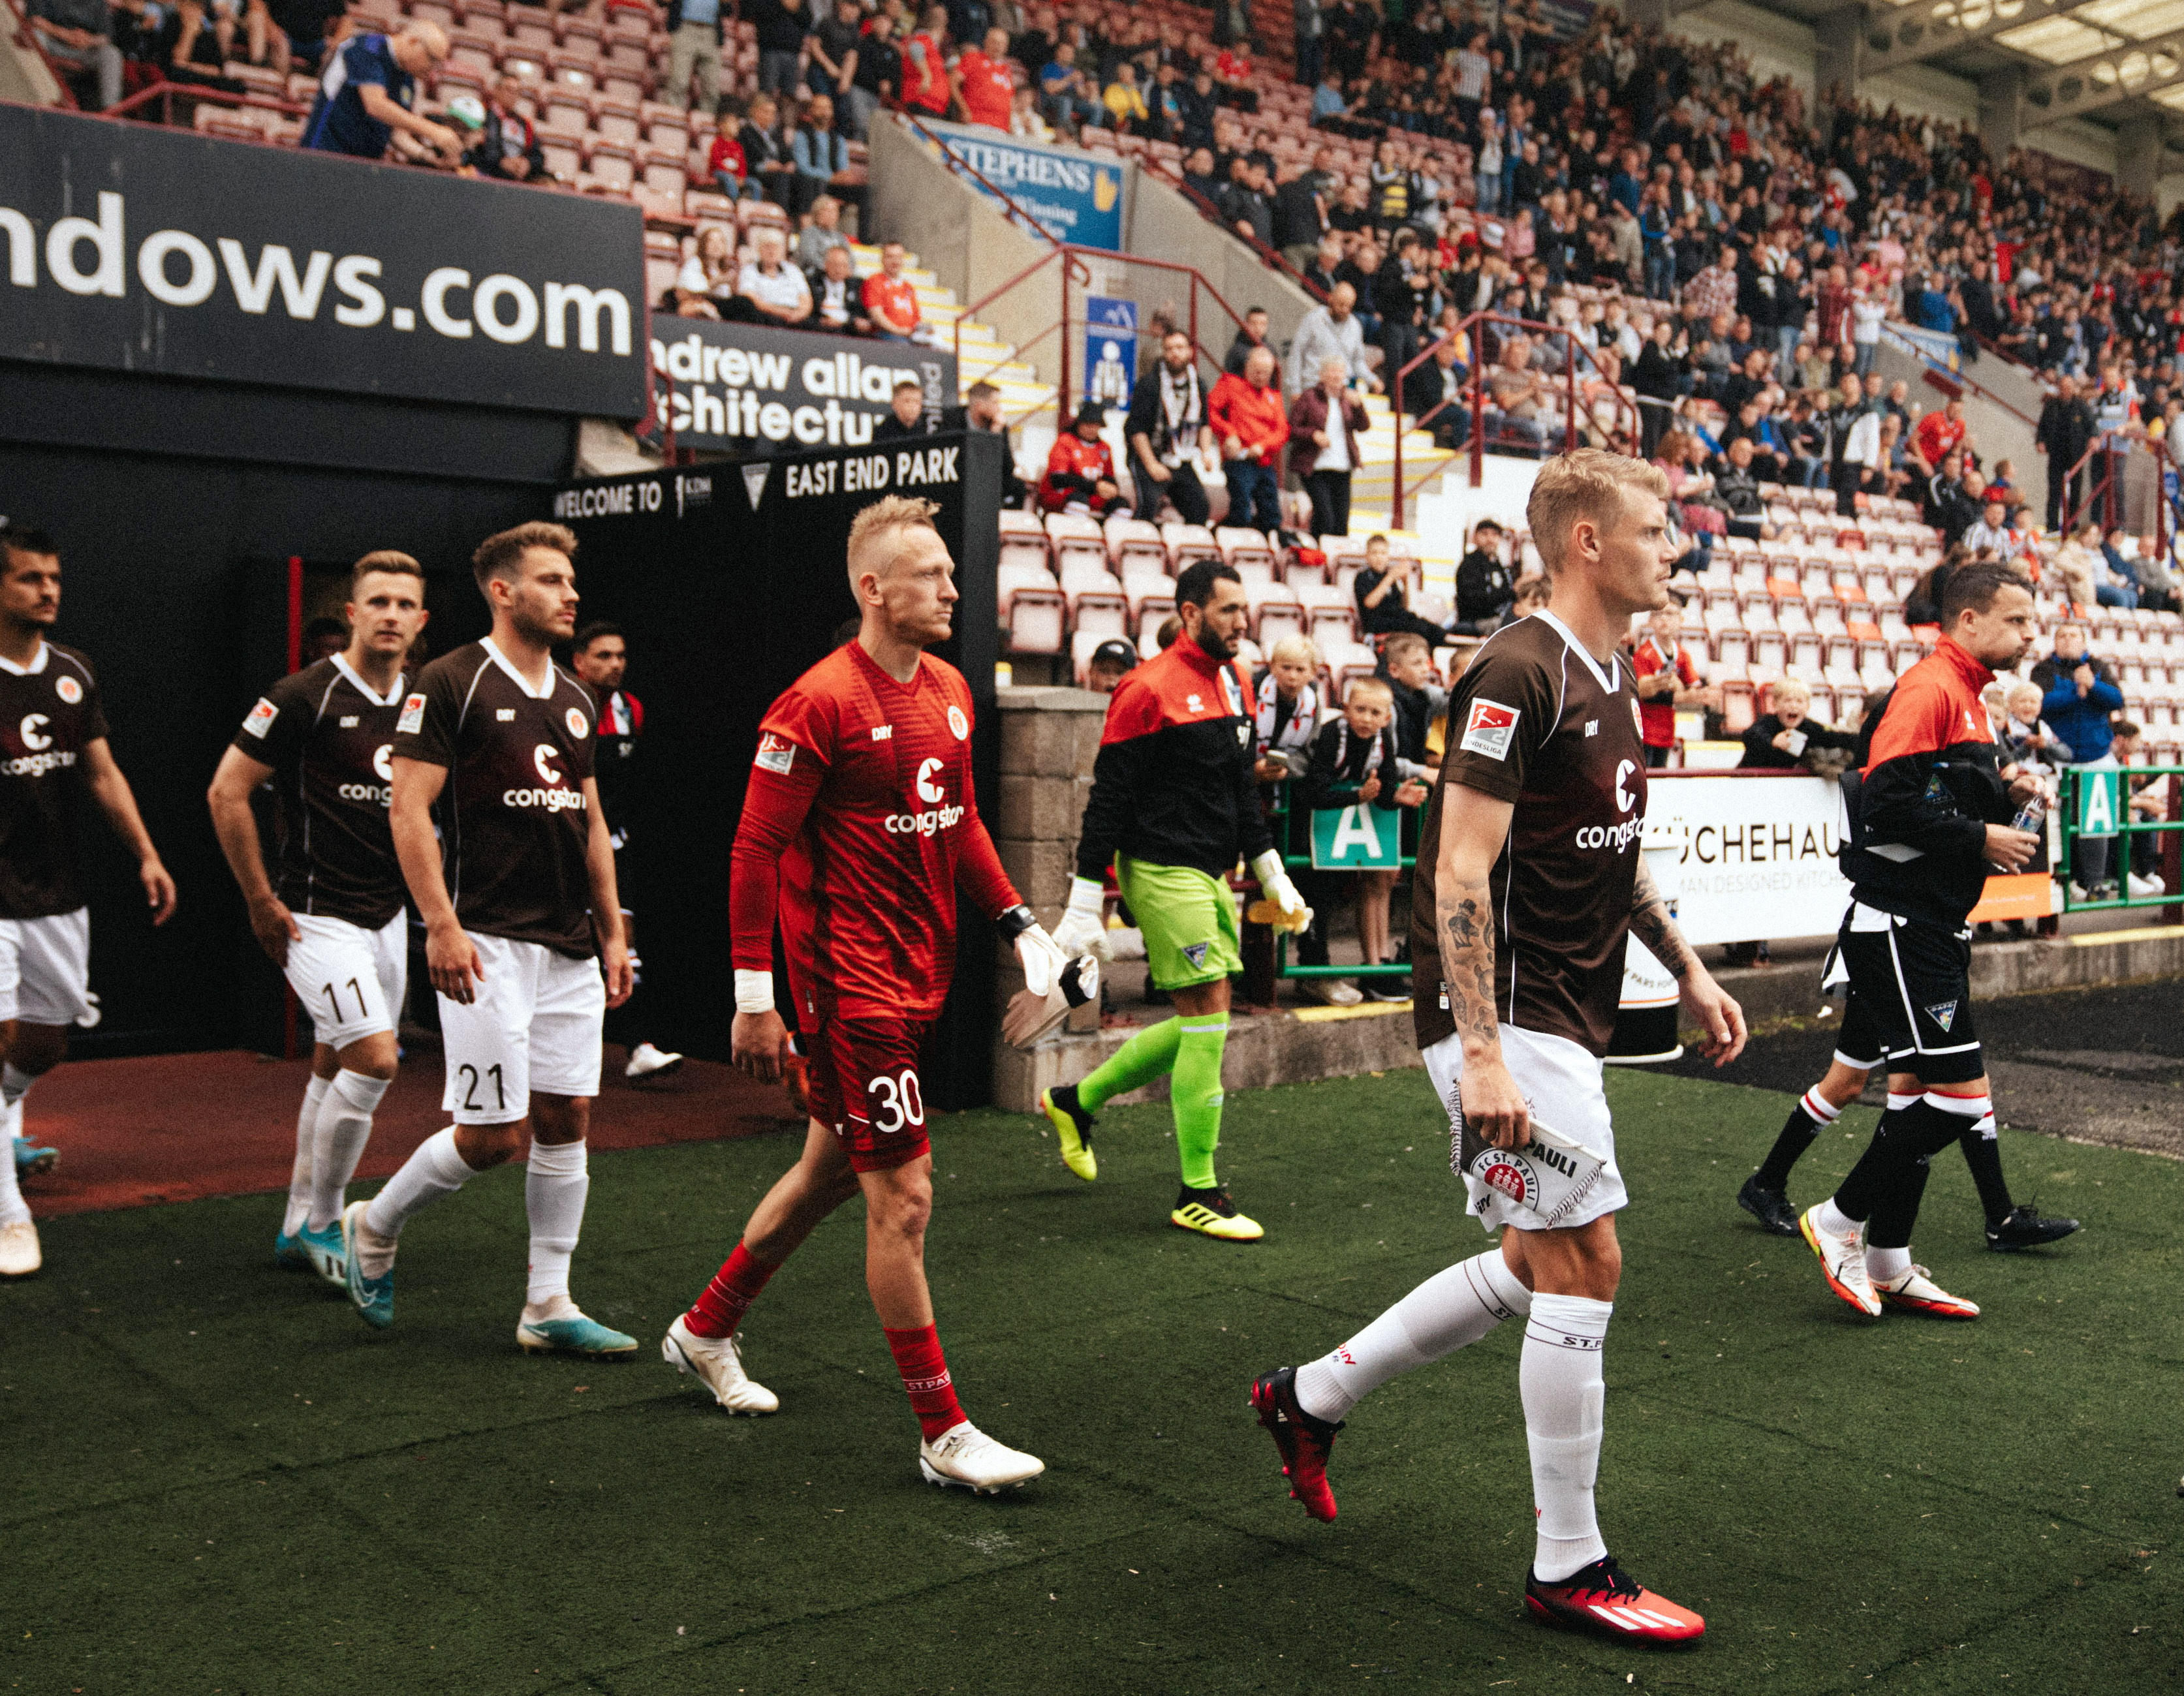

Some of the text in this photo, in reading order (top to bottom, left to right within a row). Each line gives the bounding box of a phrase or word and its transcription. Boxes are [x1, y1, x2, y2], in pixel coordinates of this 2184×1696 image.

[946, 139, 1091, 193] STEPHENS
[0, 191, 631, 356] ndows.com
[653, 384, 884, 446] chitectu
[555, 484, 633, 518] WELCOME
[638, 481, 662, 512] TO
[787, 460, 838, 498] EAST
[845, 455, 890, 491] END
[897, 446, 959, 486] PARK
[1465, 739, 1502, 754] NDESLIGA
[884, 803, 964, 837] congstar
[1332, 801, 1382, 859] A
[2085, 782, 2112, 833] A
[1653, 817, 1841, 864] ÜCHEHAU
[1714, 872, 1791, 893] DESIGNED
[322, 978, 368, 1024] 11
[458, 1063, 507, 1110] 21
[868, 1070, 923, 1132] 30
[1478, 1153, 1535, 1201] FC ST. PAULI
[1523, 1137, 1577, 1179] PAULI
